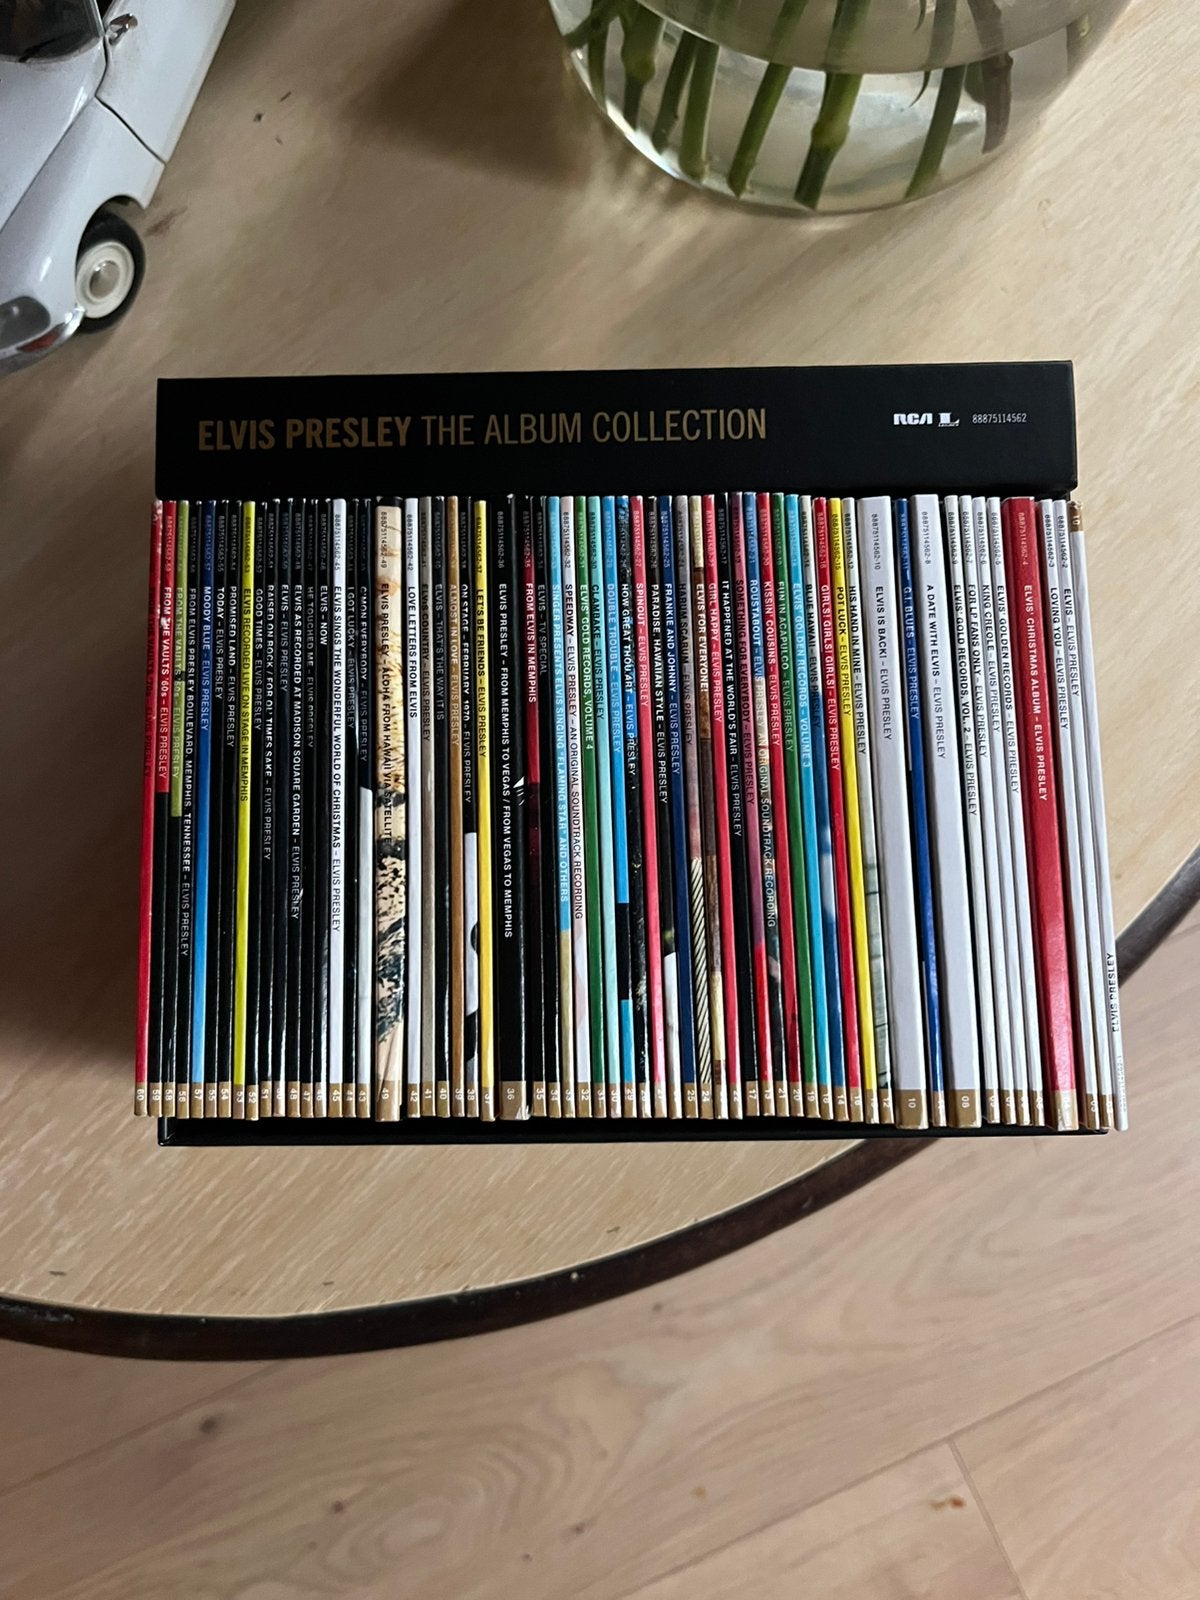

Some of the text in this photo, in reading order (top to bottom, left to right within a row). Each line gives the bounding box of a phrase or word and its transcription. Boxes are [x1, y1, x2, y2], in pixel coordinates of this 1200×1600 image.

[199, 408, 766, 450] ELVIS PRESLEY THE ALBUM COLLECTION
[893, 412, 932, 425] RCA
[972, 413, 1026, 424] 88875114562
[665, 584, 674, 625] FRANKIE
[697, 584, 705, 610] ELVIS
[875, 586, 884, 612] ELVIS
[927, 594, 936, 618] DATE
[294, 614, 301, 626] AS
[477, 619, 484, 631] BE
[877, 616, 885, 625] IS
[956, 618, 965, 644] GOLD
[526, 584, 536, 703] FROM ELVIS IN MEMPHIS
[929, 622, 938, 646] WITH
[1026, 618, 1038, 675] CHRISTMAS
[1064, 589, 1079, 696] ELVIS ELVIS PRESLEY
[698, 636, 708, 692] EVERYONE!
[931, 650, 940, 676] ELVIS
[982, 585, 1000, 732] KING CREOLE ELVIS PRESLEY
[1050, 588, 1068, 730] LOVING YOU ELVIS PRESLEY
[668, 652, 676, 692] JOHNNY
[821, 585, 839, 770] GIRLS! GIRLS! GIRLS! ELVIS PRESLEY
[880, 669, 889, 694] ELVIS
[242, 695, 249, 708] ON
[294, 687, 300, 698] AT
[933, 687, 942, 712] ELVIS
[1031, 679, 1041, 713] ALBUM
[584, 700, 592, 741] VOLUME
[669, 703, 678, 728] ELVIS
[722, 581, 741, 836] IT HAPPENED AT THE WORLD'S FAIR ELVIS PRESLEY
[881, 698, 891, 740] PRESLEY
[961, 702, 970, 724] VOL.
[242, 745, 249, 754] IN
[935, 716, 945, 758] PRESLEY
[1034, 725, 1043, 751] ELVIS
[502, 748, 509, 760] TO
[565, 584, 582, 919] SPEEDWAY ELVIS PRESLEY AN ORIGINAL SOUNDTRACK RECORDING
[670, 732, 679, 774] PRESLEY
[964, 744, 974, 769] ELVIS
[333, 774, 341, 786] OF
[1036, 755, 1047, 800] PRESLEY
[966, 772, 977, 815] PRESLEY
[503, 873, 511, 886] TO
[504, 890, 512, 938] MEMPHIS
[1106, 953, 1119, 1032] ELVIS PRESLEY
[137, 1089, 144, 1100] 60
[194, 1089, 202, 1100] 57
[248, 1092, 256, 1103] 52
[439, 1088, 447, 1099] 40
[507, 1088, 514, 1100] 36
[581, 1089, 588, 1100] 32
[908, 1098, 916, 1108] 10
[961, 1096, 969, 1108] 08
